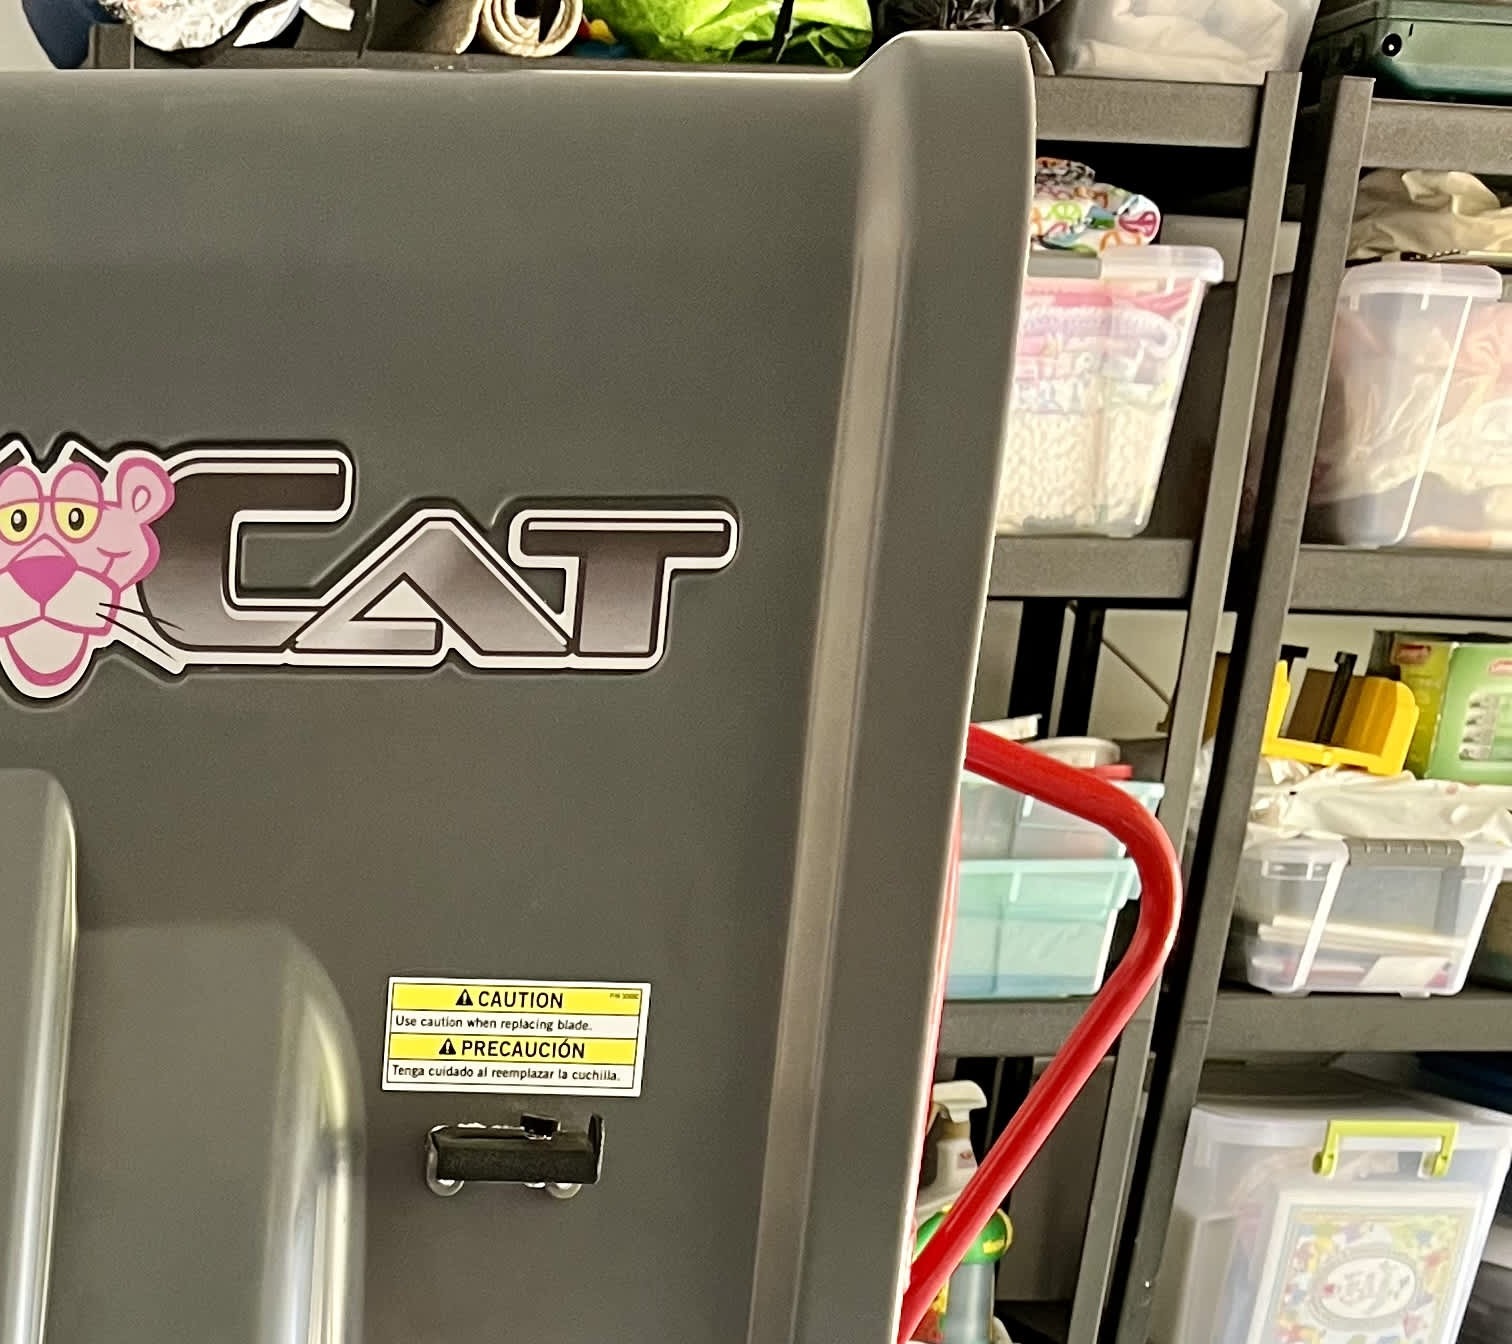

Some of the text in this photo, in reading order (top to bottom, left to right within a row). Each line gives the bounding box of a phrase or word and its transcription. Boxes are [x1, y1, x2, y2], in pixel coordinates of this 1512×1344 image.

[478, 990, 564, 1009] CAUTION
[395, 1016, 592, 1032] Use caution when replacing blade.
[461, 1038, 585, 1059] PRECAUCIÓN
[392, 1064, 621, 1082] Tenga cuidado al reemplazar la cuchilla.
